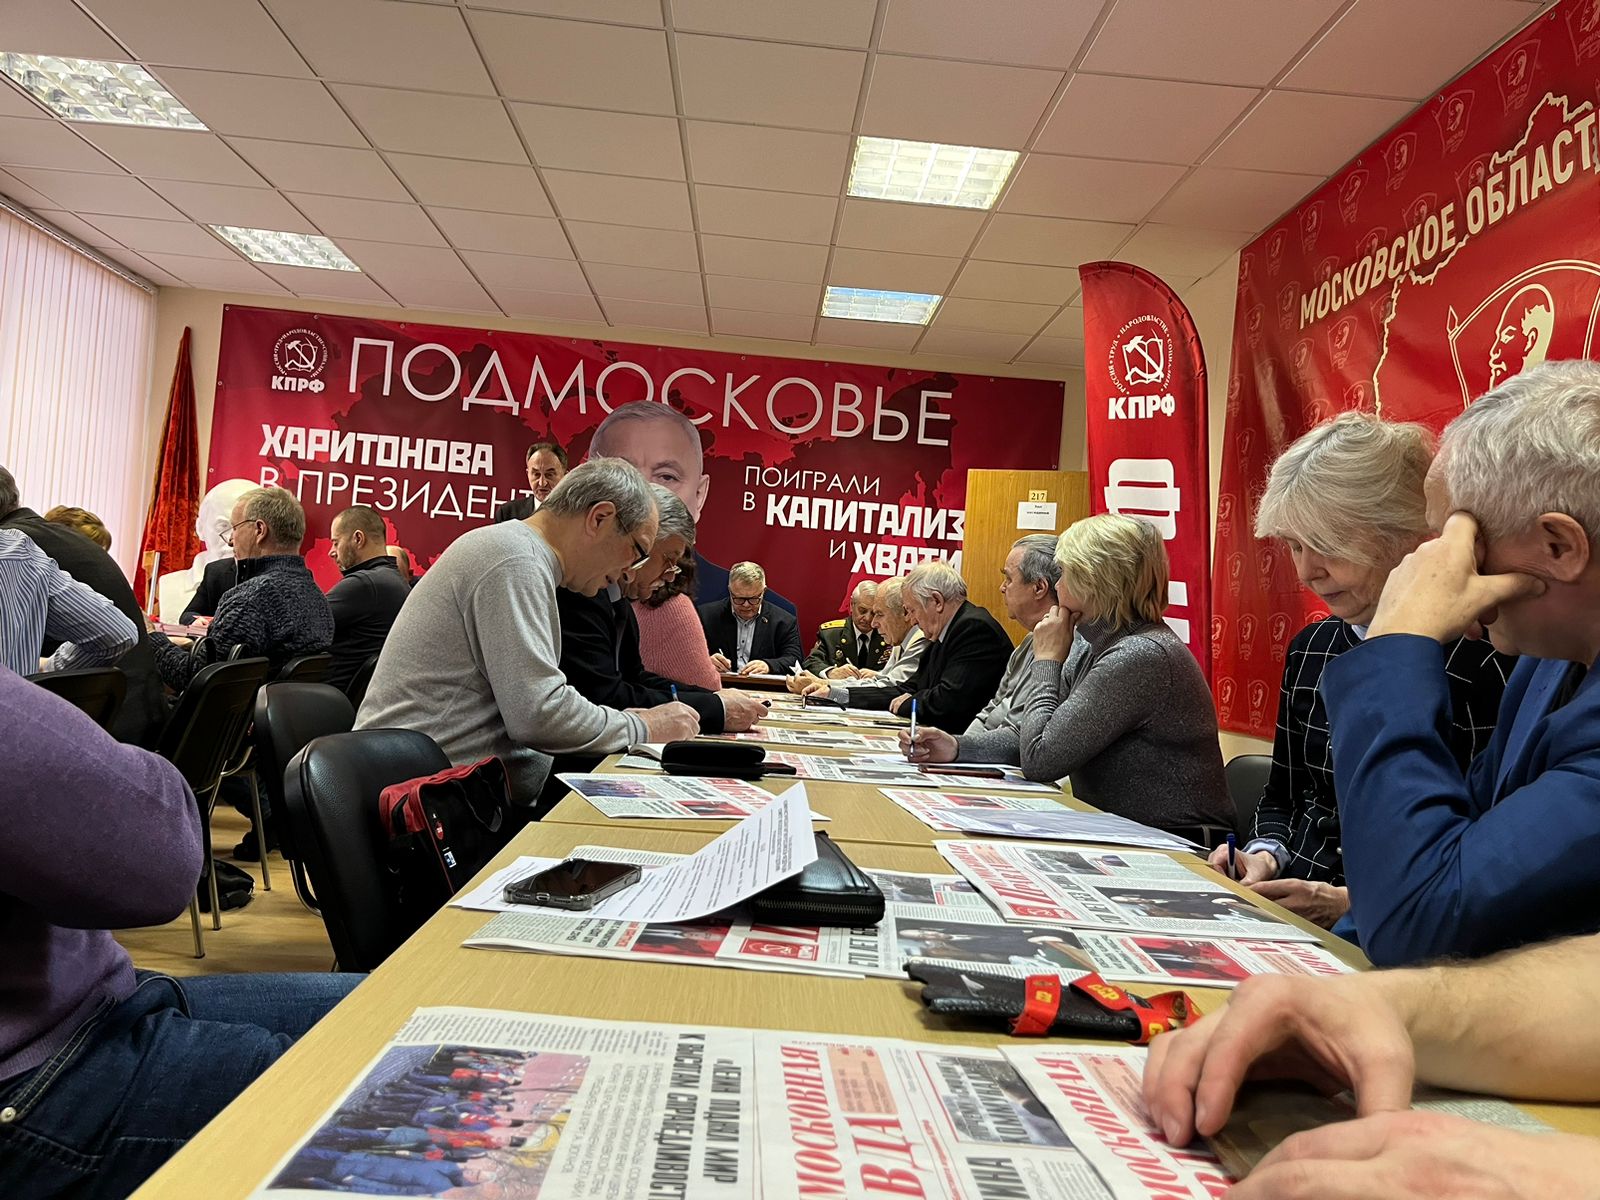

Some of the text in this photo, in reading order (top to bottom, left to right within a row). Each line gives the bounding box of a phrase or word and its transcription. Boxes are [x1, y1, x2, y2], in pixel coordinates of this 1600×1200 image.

[1300, 111, 1599, 330] МОСКОВСКОЕ ОБЛАСТ
[1109, 339, 1119, 360] ТРУД
[271, 375, 325, 393] КПРФ
[348, 336, 954, 447] ПОДМОСКОВЬЕ
[1108, 393, 1176, 420] КПРФ
[258, 424, 494, 477] ХАРИТОНОВА
[259, 466, 534, 522] В ПРЕЗИДЕН
[744, 465, 881, 497] ПОИГРАЛИ
[1031, 492, 1045, 501] 217
[743, 492, 966, 541] В КАПИТАЛИЗ
[829, 539, 846, 560] И
[850, 925, 879, 967] СТО ЛЕТ БЕ
[669, 1042, 705, 1089] ВЫСОТАМ
[703, 1098, 741, 1142] ПОДНЯЛ
[780, 1044, 848, 1200] МОСКОВНАЯ
[647, 1092, 698, 1200] СПРАВЕДЛИВОСТ
[703, 1147, 739, 1184] МИР
